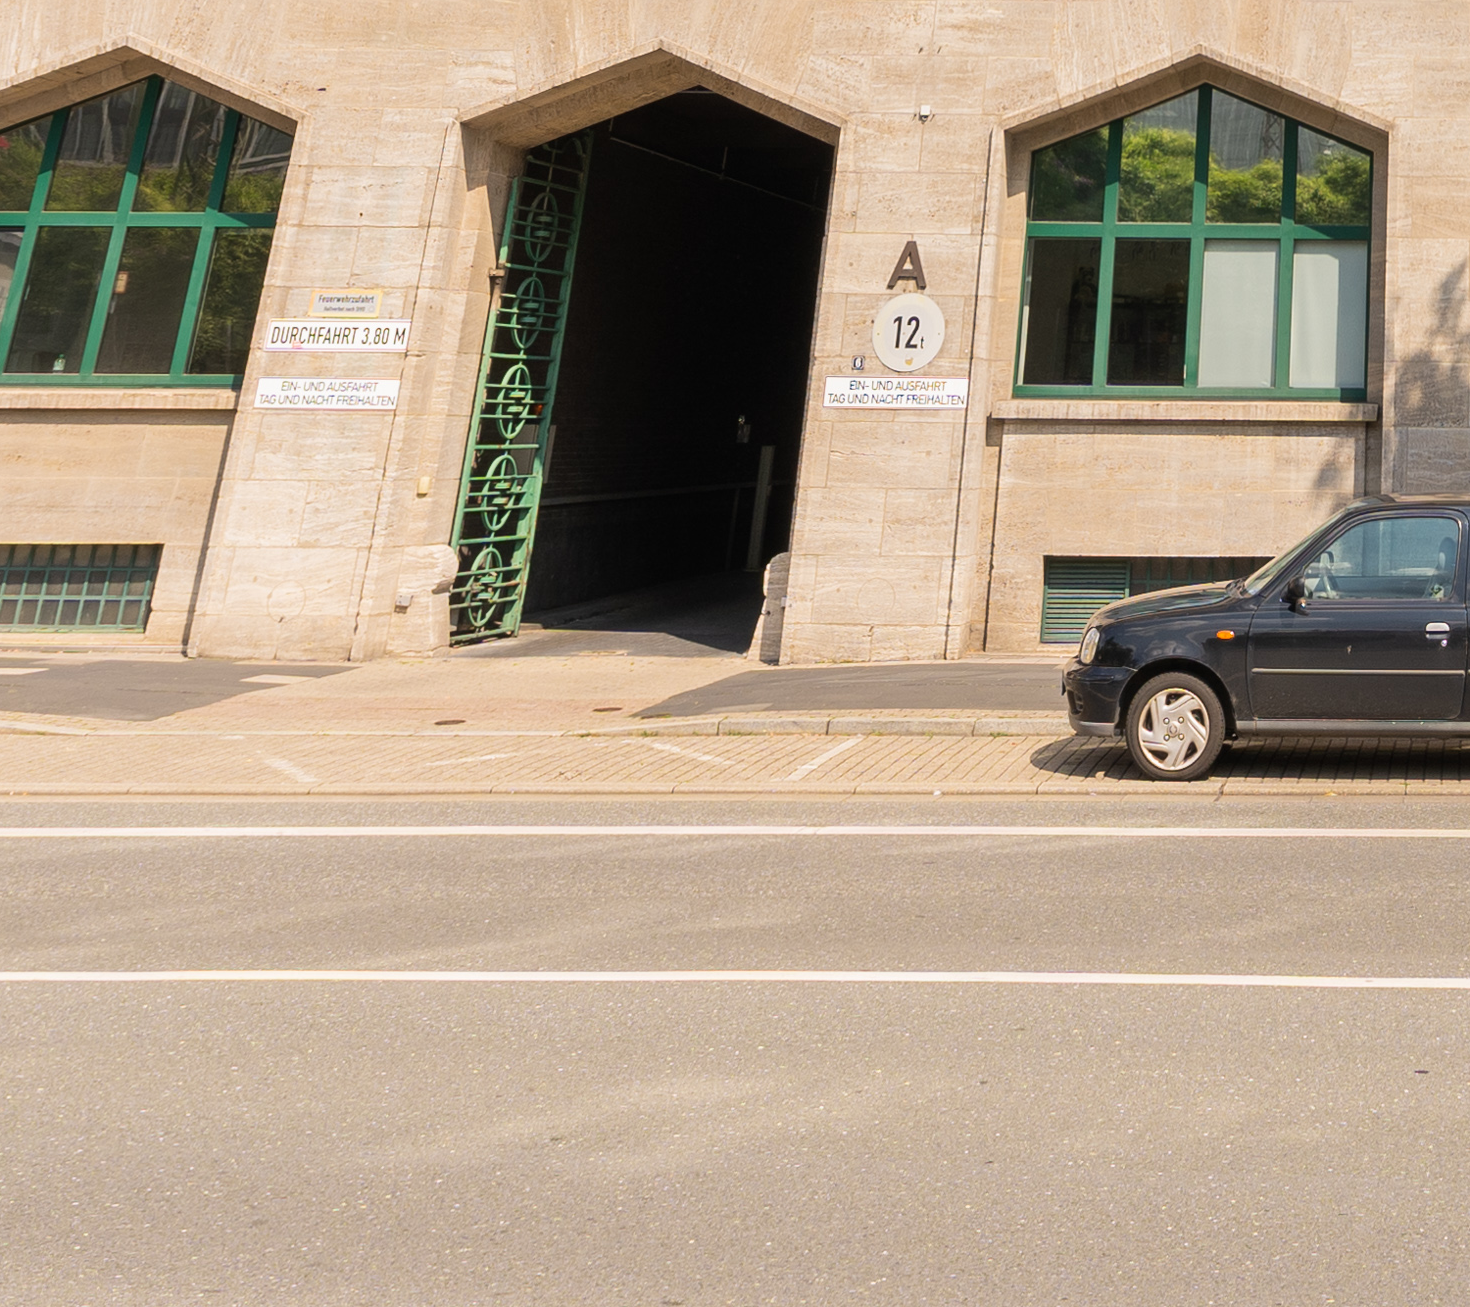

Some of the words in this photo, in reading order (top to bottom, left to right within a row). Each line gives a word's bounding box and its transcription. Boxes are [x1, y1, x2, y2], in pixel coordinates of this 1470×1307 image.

[886, 241, 927, 290] A
[318, 294, 375, 304] Feuerwehrzufahrt
[271, 326, 359, 345] DURCHFAHRT
[393, 327, 407, 345] M
[281, 381, 301, 392] EIN-
[303, 381, 325, 392] UND
[325, 382, 378, 392] AUSFAHRT
[849, 380, 869, 391] EIN-
[871, 380, 893, 391] UND
[894, 381, 947, 392] AUSFAHRT
[259, 394, 277, 405] TAG
[278, 395, 300, 405] UND
[302, 395, 335, 406] NACHT
[336, 395, 396, 406] FREIHALTEN
[828, 393, 846, 404] TAG
[847, 393, 869, 404] UND
[871, 394, 904, 405] NACHT
[906, 394, 965, 405] FREIHALTEN
